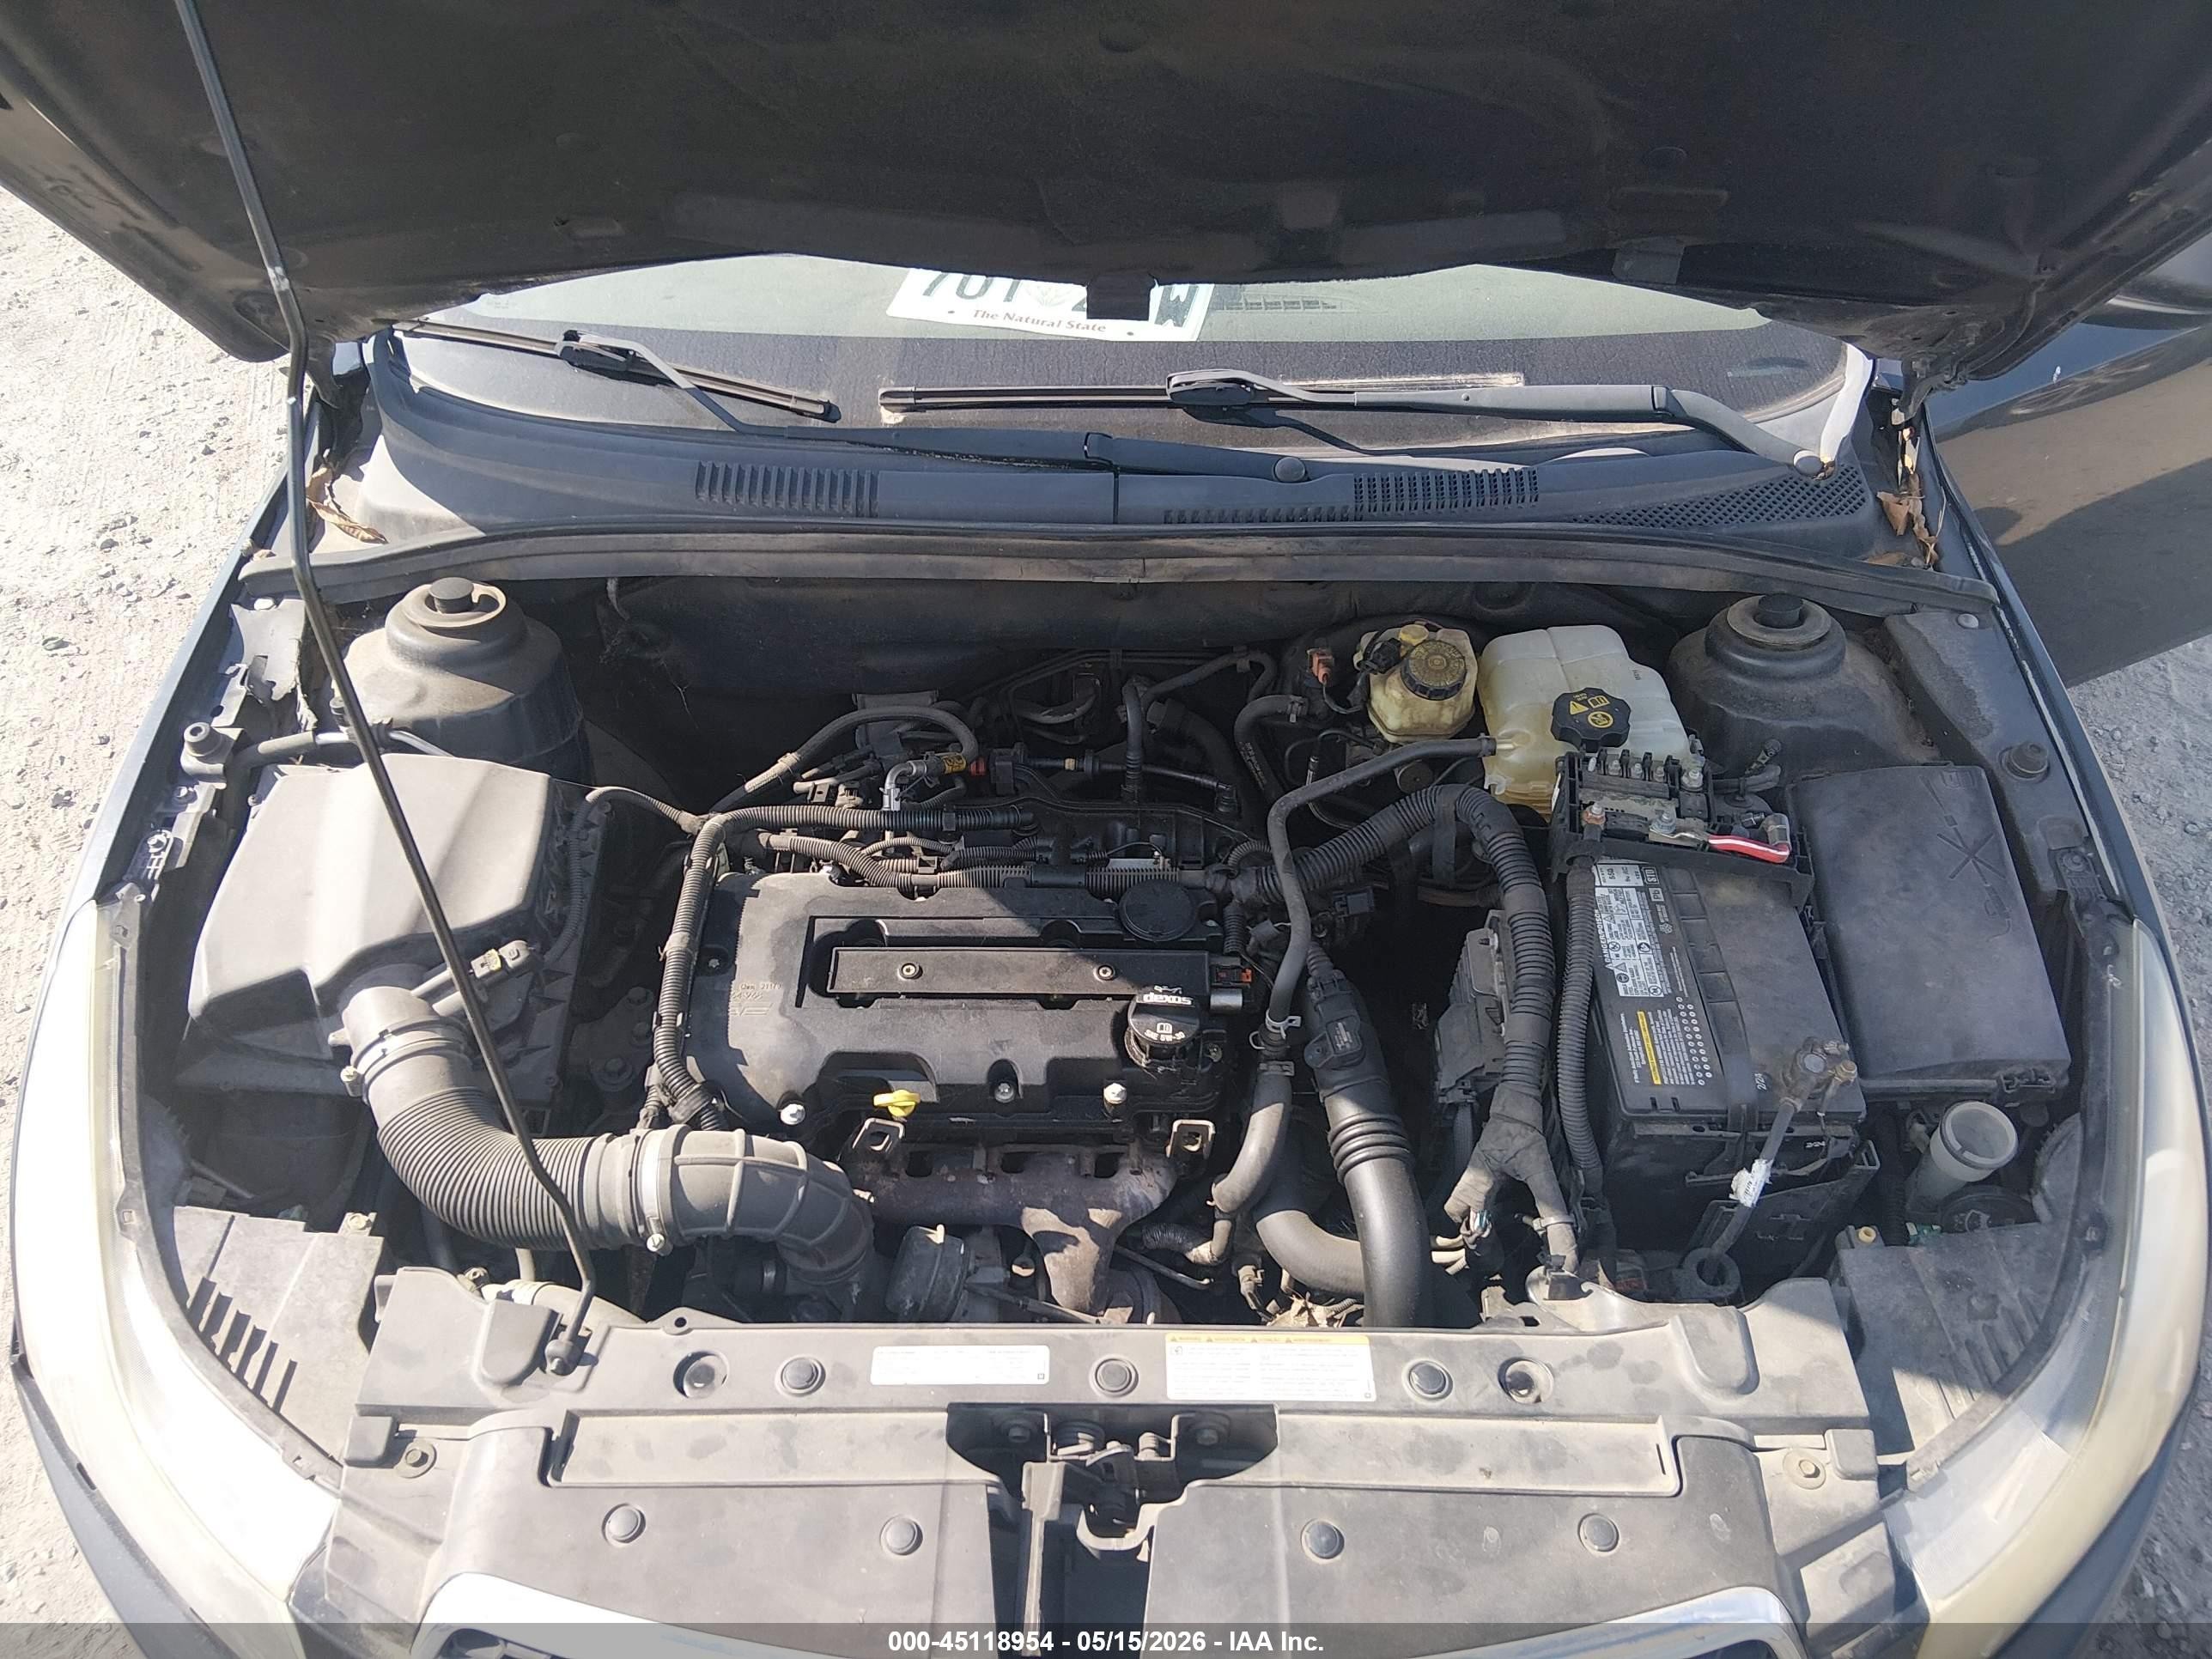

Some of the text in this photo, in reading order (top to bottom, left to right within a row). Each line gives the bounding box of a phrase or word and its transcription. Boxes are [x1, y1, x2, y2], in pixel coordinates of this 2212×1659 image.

[973, 309, 1107, 332] The Natural State
[1651, 890, 1662, 900] Pb
[1143, 992, 1194, 1005] dexos
